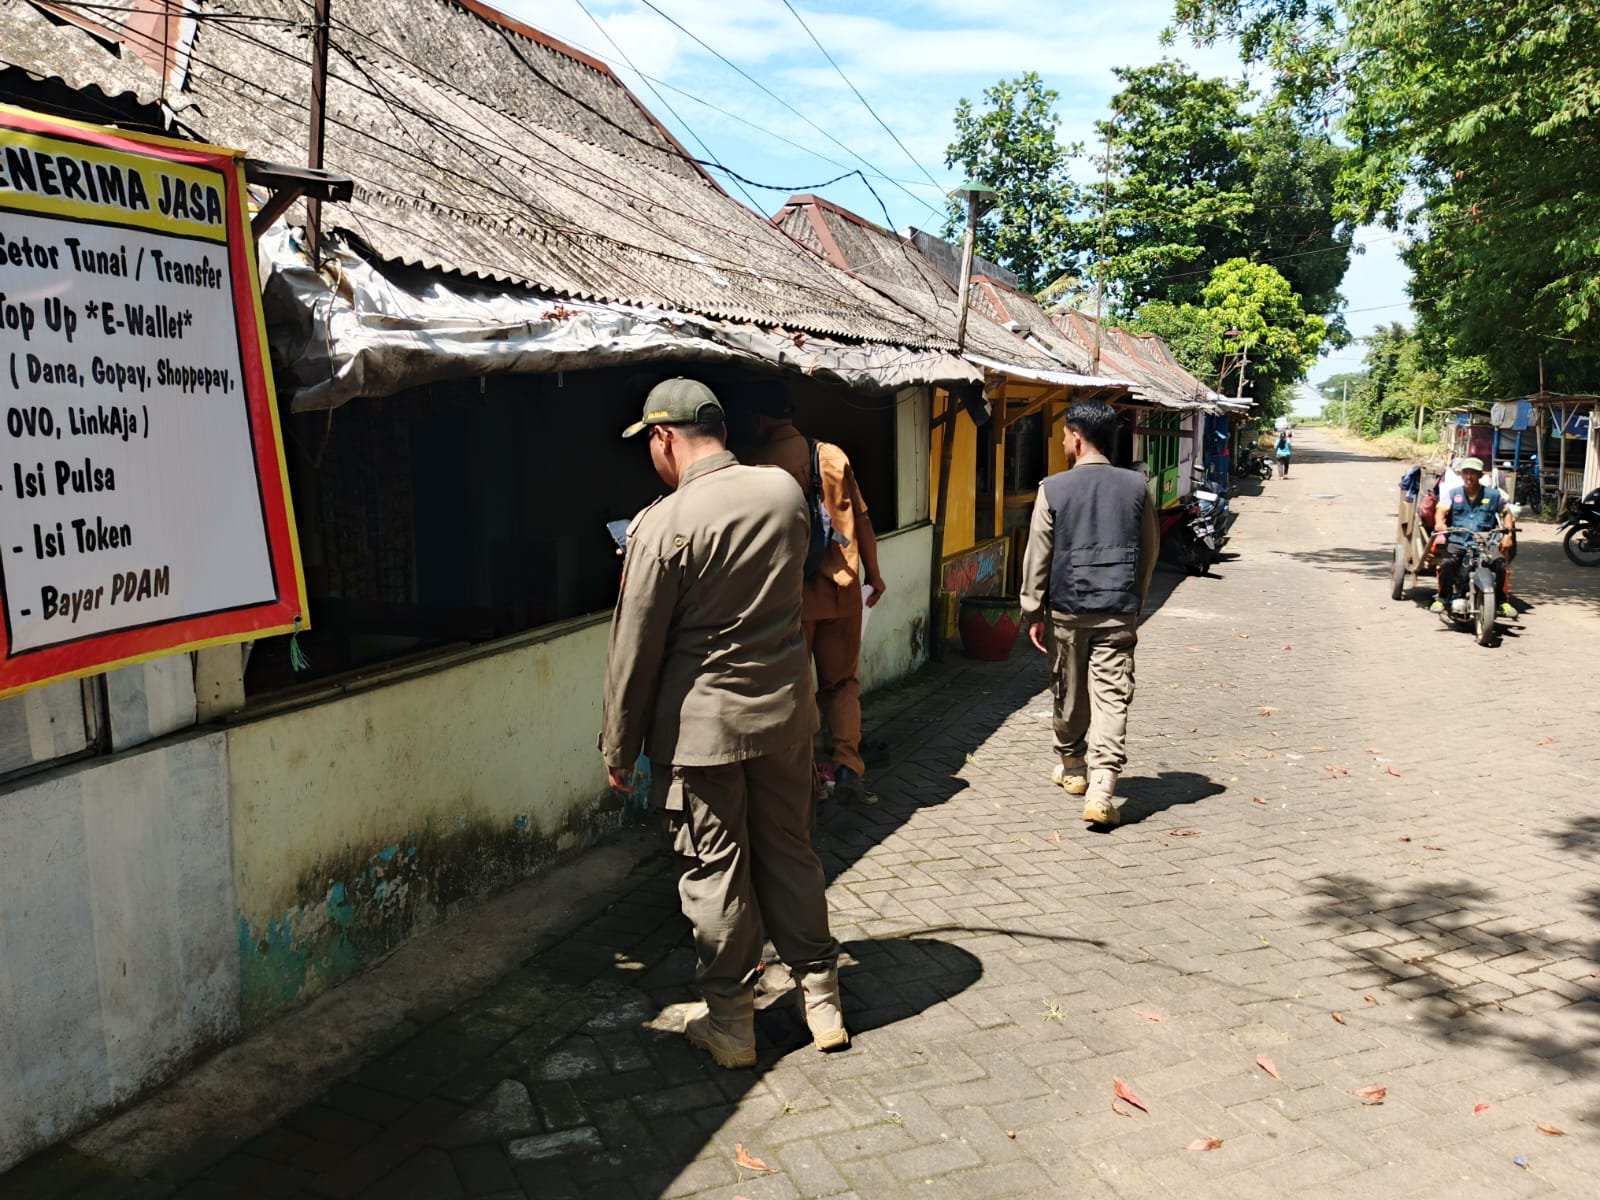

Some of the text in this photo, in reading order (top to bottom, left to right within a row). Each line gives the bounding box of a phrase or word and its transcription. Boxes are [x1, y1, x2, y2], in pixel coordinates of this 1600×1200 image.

[157, 174, 223, 225] JASA
[63, 237, 129, 278] Tunai
[135, 246, 145, 282] /
[150, 249, 223, 290] Transfer
[44, 296, 77, 344] Up
[26, 353, 85, 388] Dana,
[91, 355, 152, 393] Gopay,
[156, 357, 235, 395] Shoppepay,
[6, 406, 62, 440] OVO,
[13, 457, 116, 500] Isi Pulsa
[33, 522, 66, 560] Isi
[70, 515, 132, 554] Token
[40, 585, 104, 624] Bayar
[110, 565, 170, 606] PDAM
